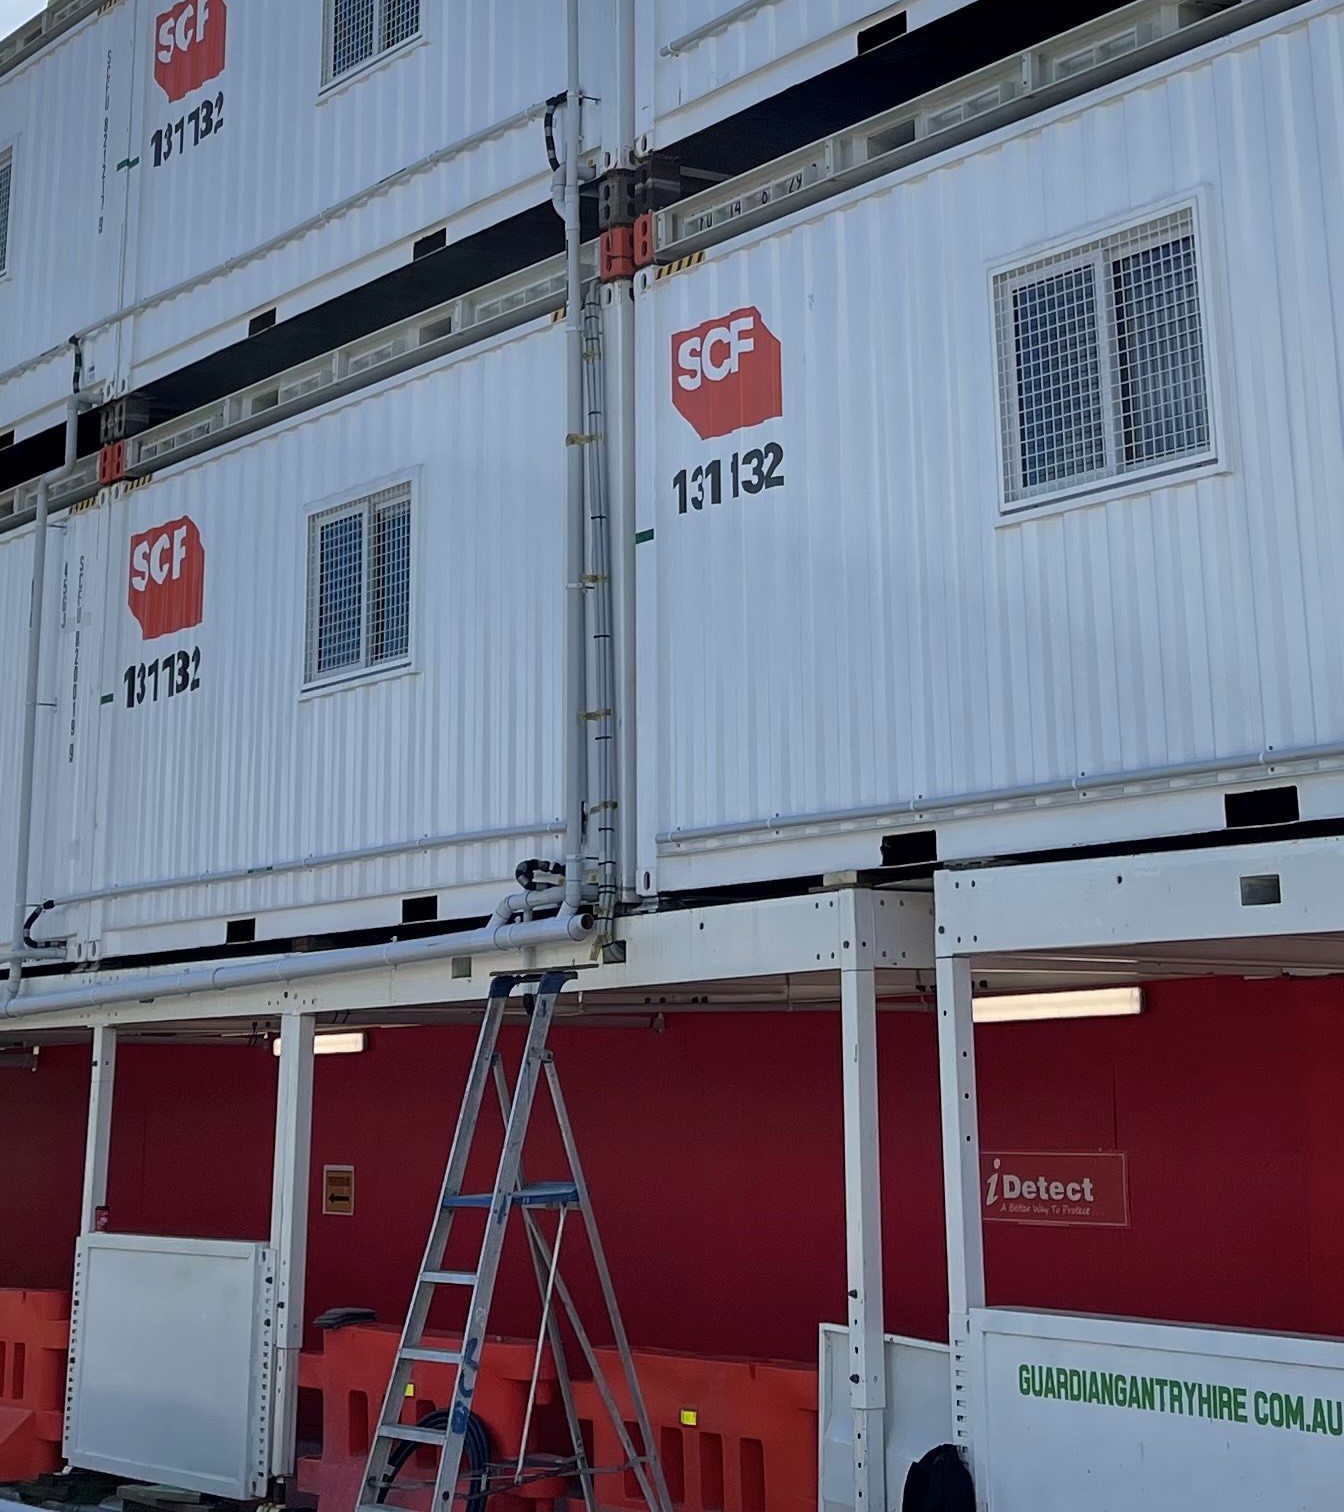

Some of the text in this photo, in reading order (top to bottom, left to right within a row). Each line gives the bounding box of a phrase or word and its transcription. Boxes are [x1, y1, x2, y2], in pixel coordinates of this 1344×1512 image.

[150, 91, 224, 168] 131 132
[677, 316, 754, 391] SCF
[673, 442, 785, 515] 131 132
[131, 525, 187, 592] SCF
[123, 645, 201, 709] 131 132
